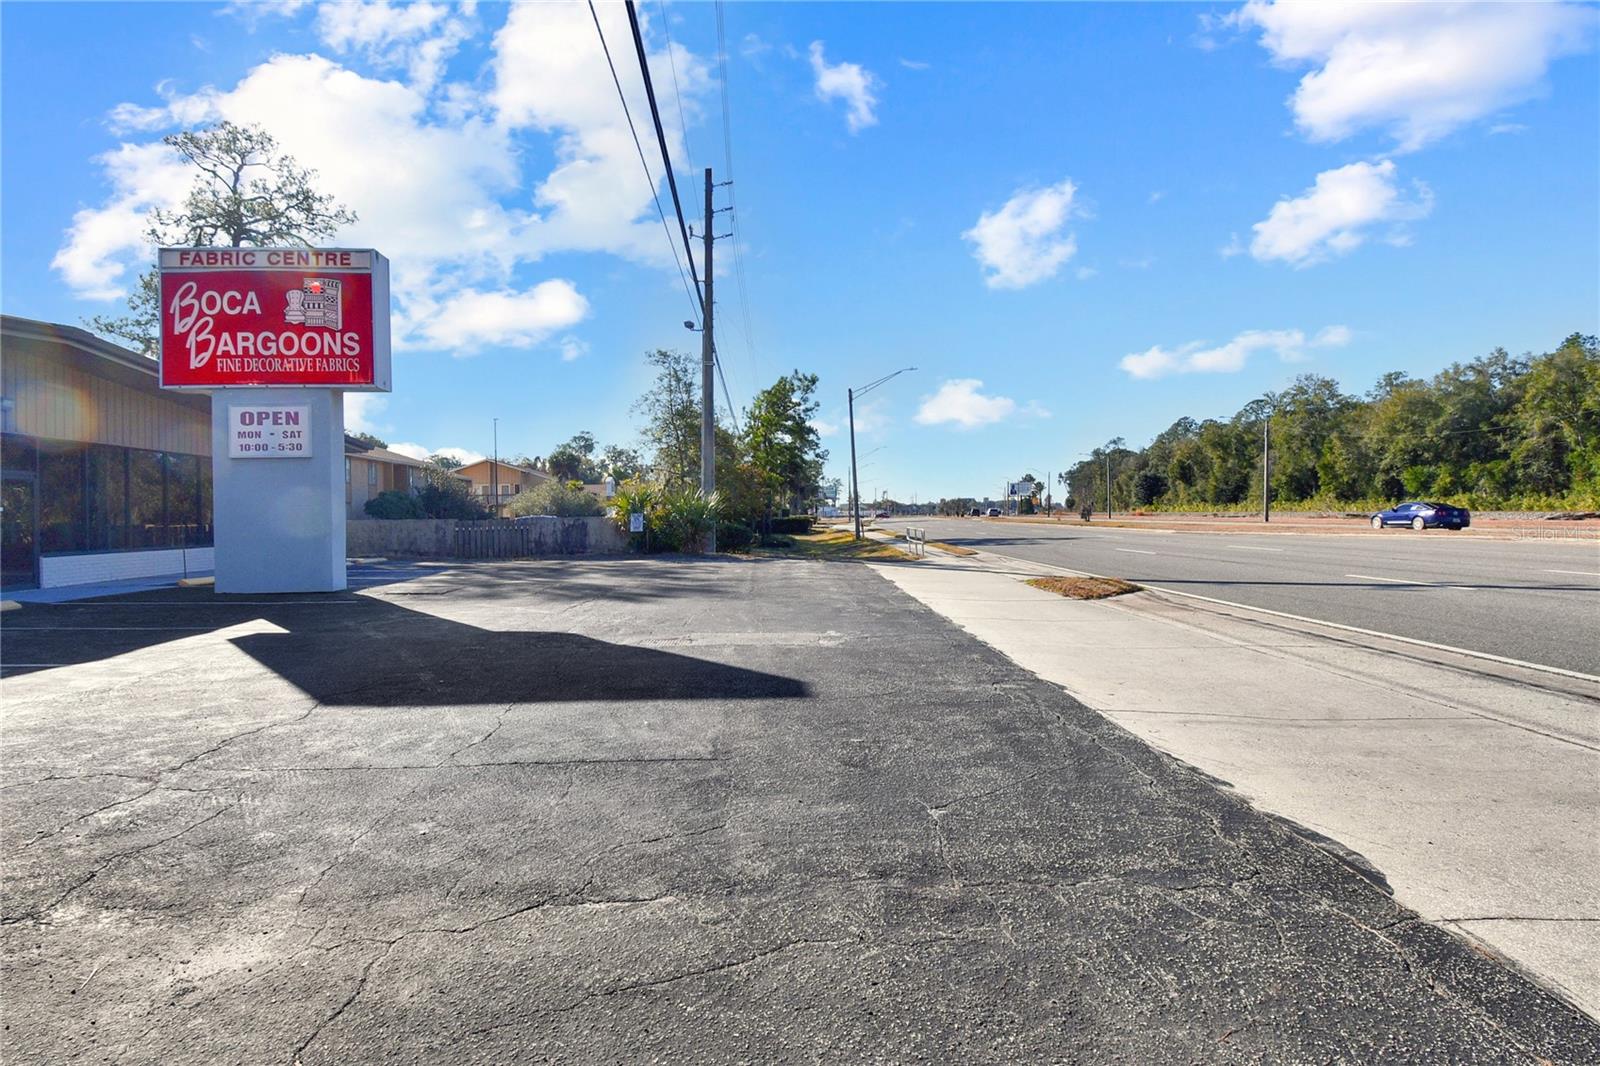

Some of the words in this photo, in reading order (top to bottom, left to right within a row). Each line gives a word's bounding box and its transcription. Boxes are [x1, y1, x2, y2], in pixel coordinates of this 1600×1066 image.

[180, 252, 255, 265] FABRIC
[267, 252, 352, 265] CENTRE
[170, 281, 262, 335] BOCA
[185, 317, 360, 370] BARGOONS
[217, 358, 242, 372] FINE
[244, 358, 313, 372] DECORATIVE
[316, 358, 360, 372] FABRICS
[240, 411, 299, 426] OPEN
[237, 431, 262, 439] MON
[282, 431, 303, 439] SAT
[239, 443, 269, 452] 10:00
[278, 443, 303, 452] 5:30
